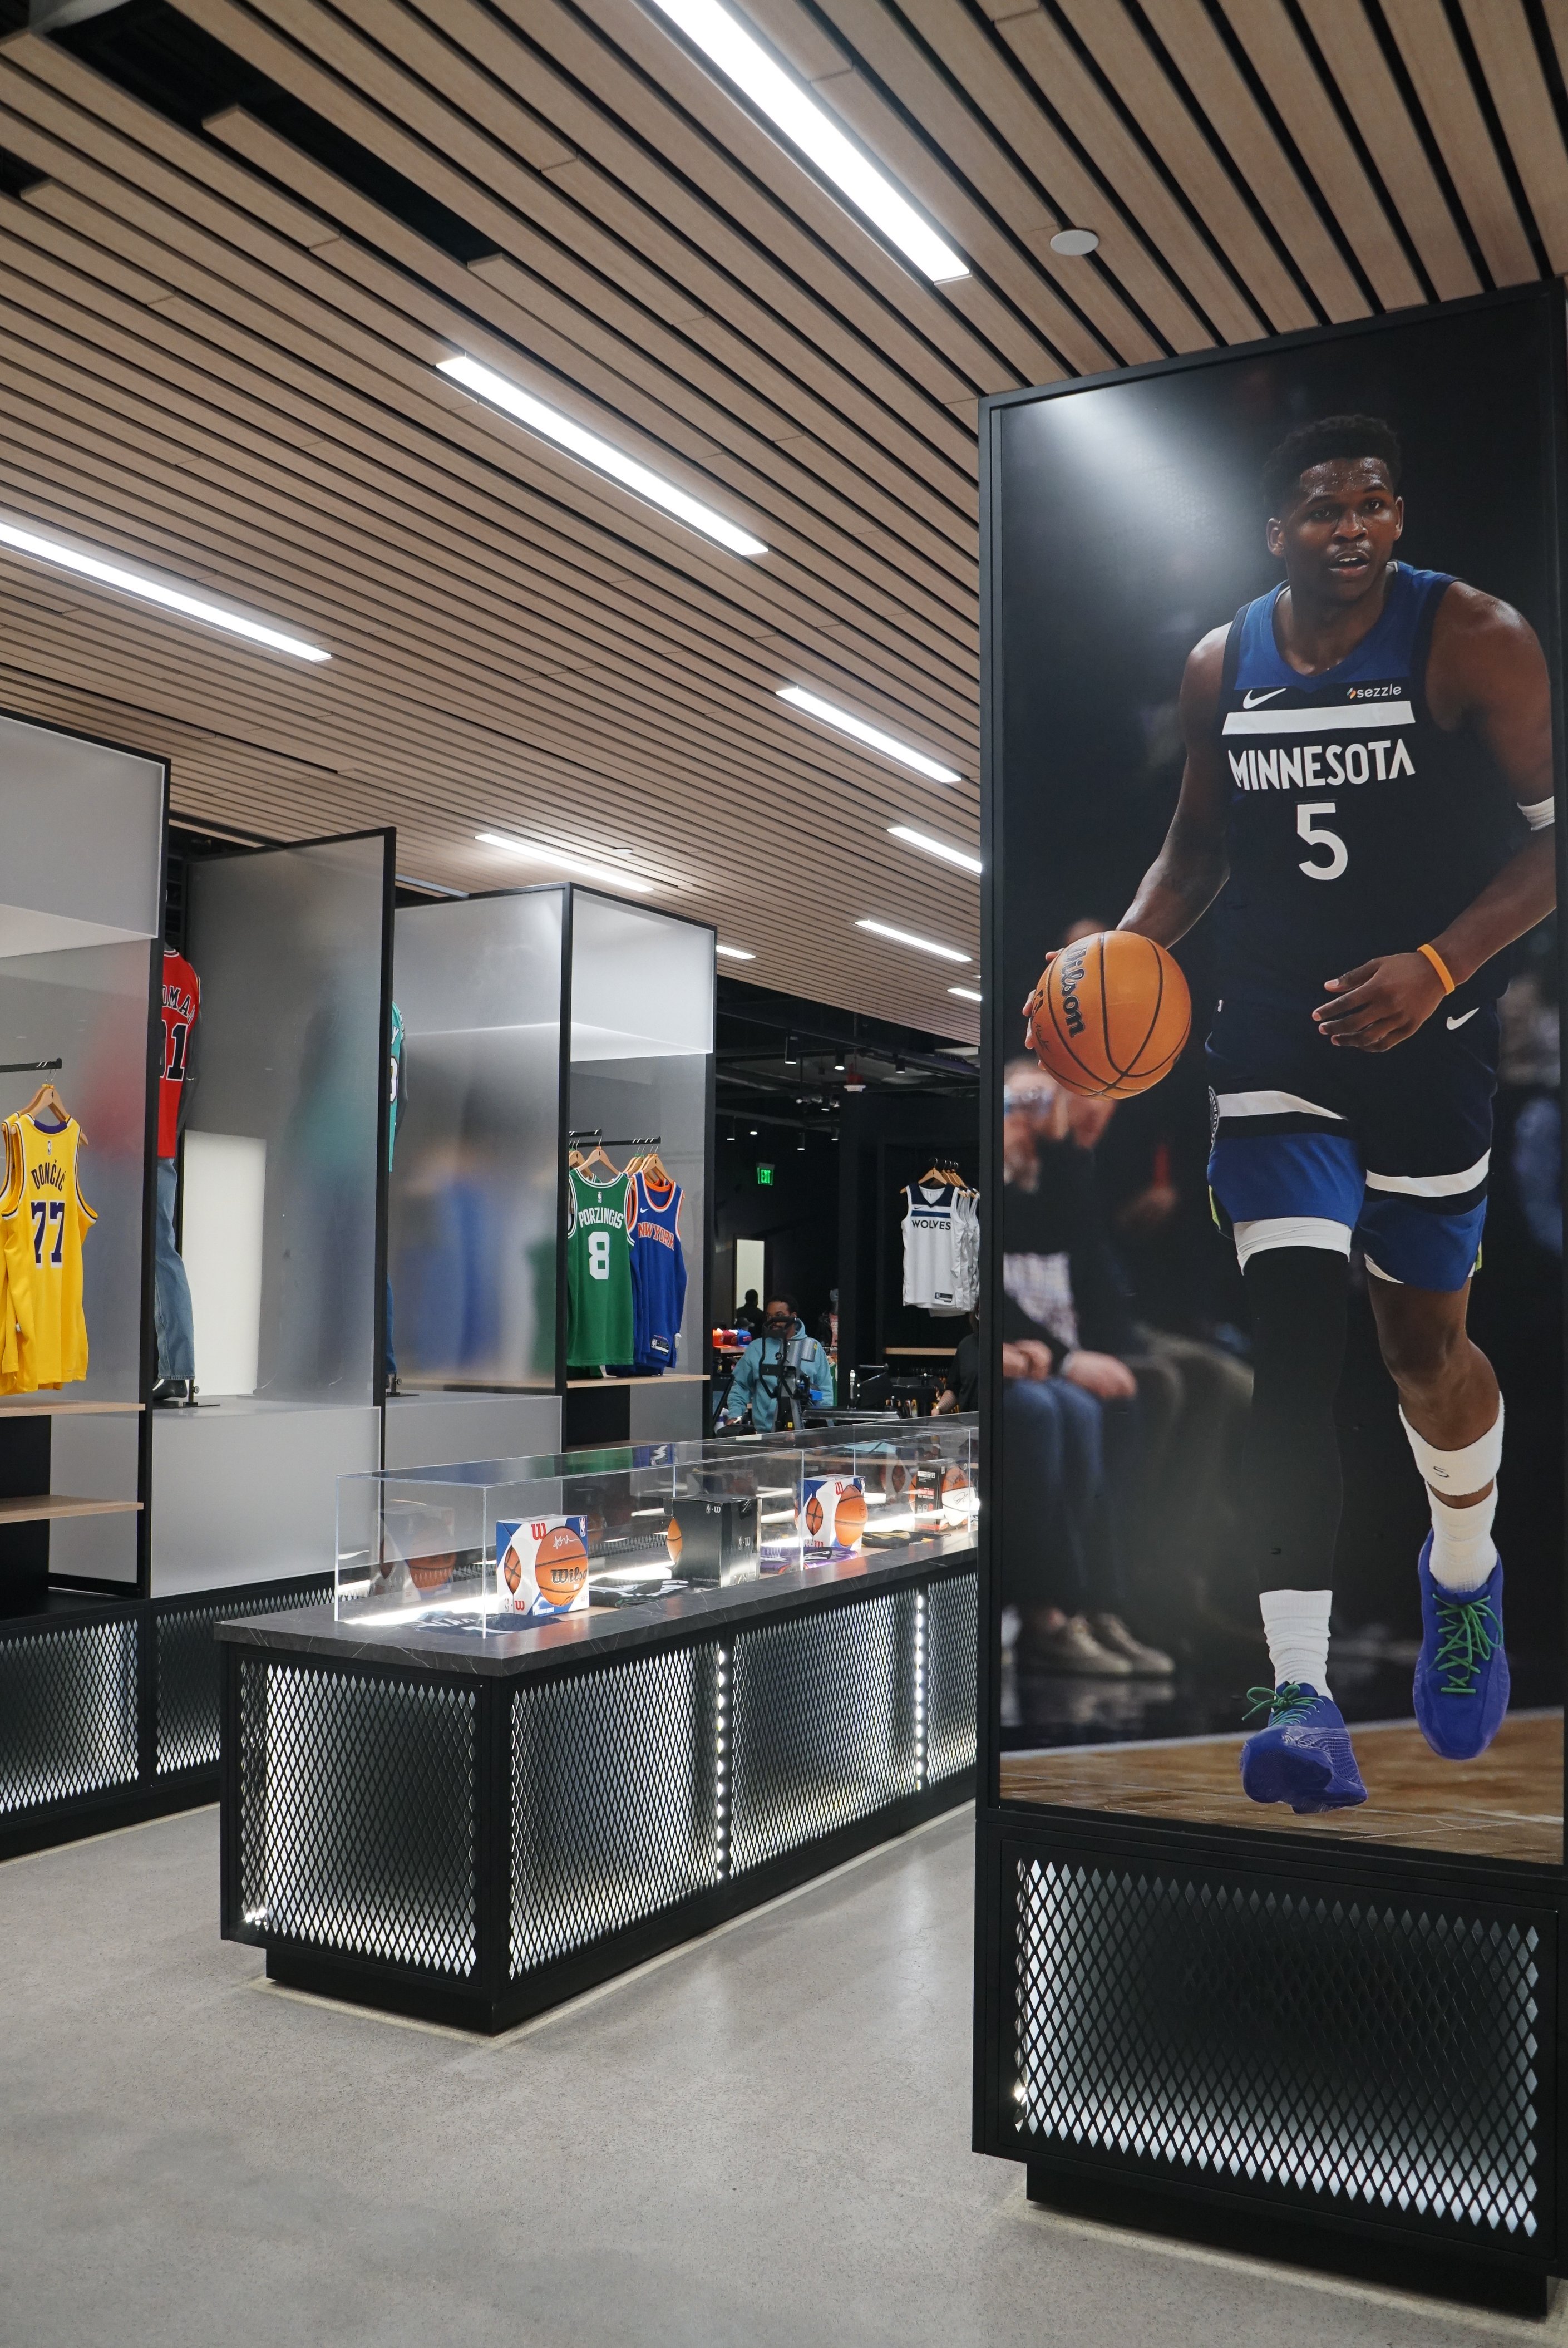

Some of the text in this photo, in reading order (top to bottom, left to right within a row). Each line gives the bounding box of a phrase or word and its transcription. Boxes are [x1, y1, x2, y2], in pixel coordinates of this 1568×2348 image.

[1357, 683, 1402, 698] sezzle
[1228, 739, 1416, 790] MINNESOTA
[1297, 803, 1348, 880] 5
[31, 1159, 66, 1192] DONČIĆ
[761, 1169, 771, 1184] EXIT
[578, 1207, 624, 1229] PORZINGIS
[911, 1219, 951, 1230] WOLVES
[30, 1200, 66, 1269] 77
[653, 1224, 674, 1251] YORK
[588, 1232, 610, 1280] 8
